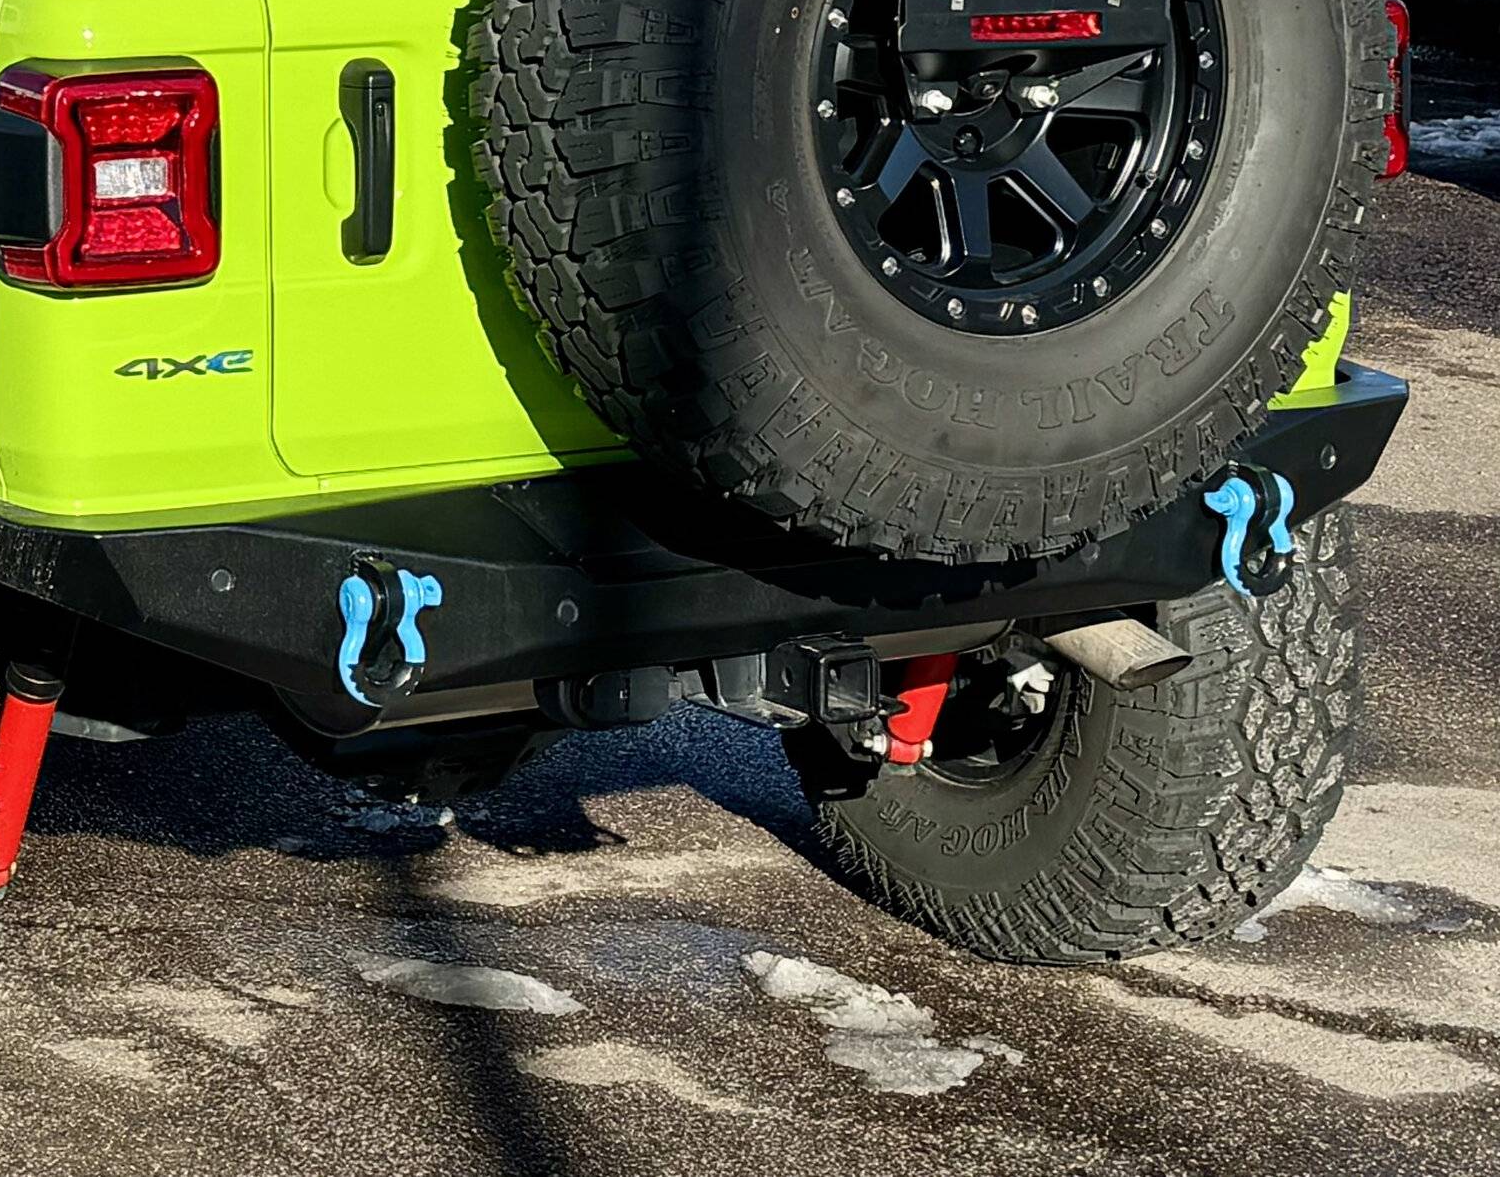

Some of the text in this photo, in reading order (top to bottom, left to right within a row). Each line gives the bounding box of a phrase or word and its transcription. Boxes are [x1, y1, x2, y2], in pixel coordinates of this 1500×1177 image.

[857, 339, 1003, 430] HOG
[1020, 289, 1236, 430] TRAIL
[940, 805, 1030, 857] HOG
